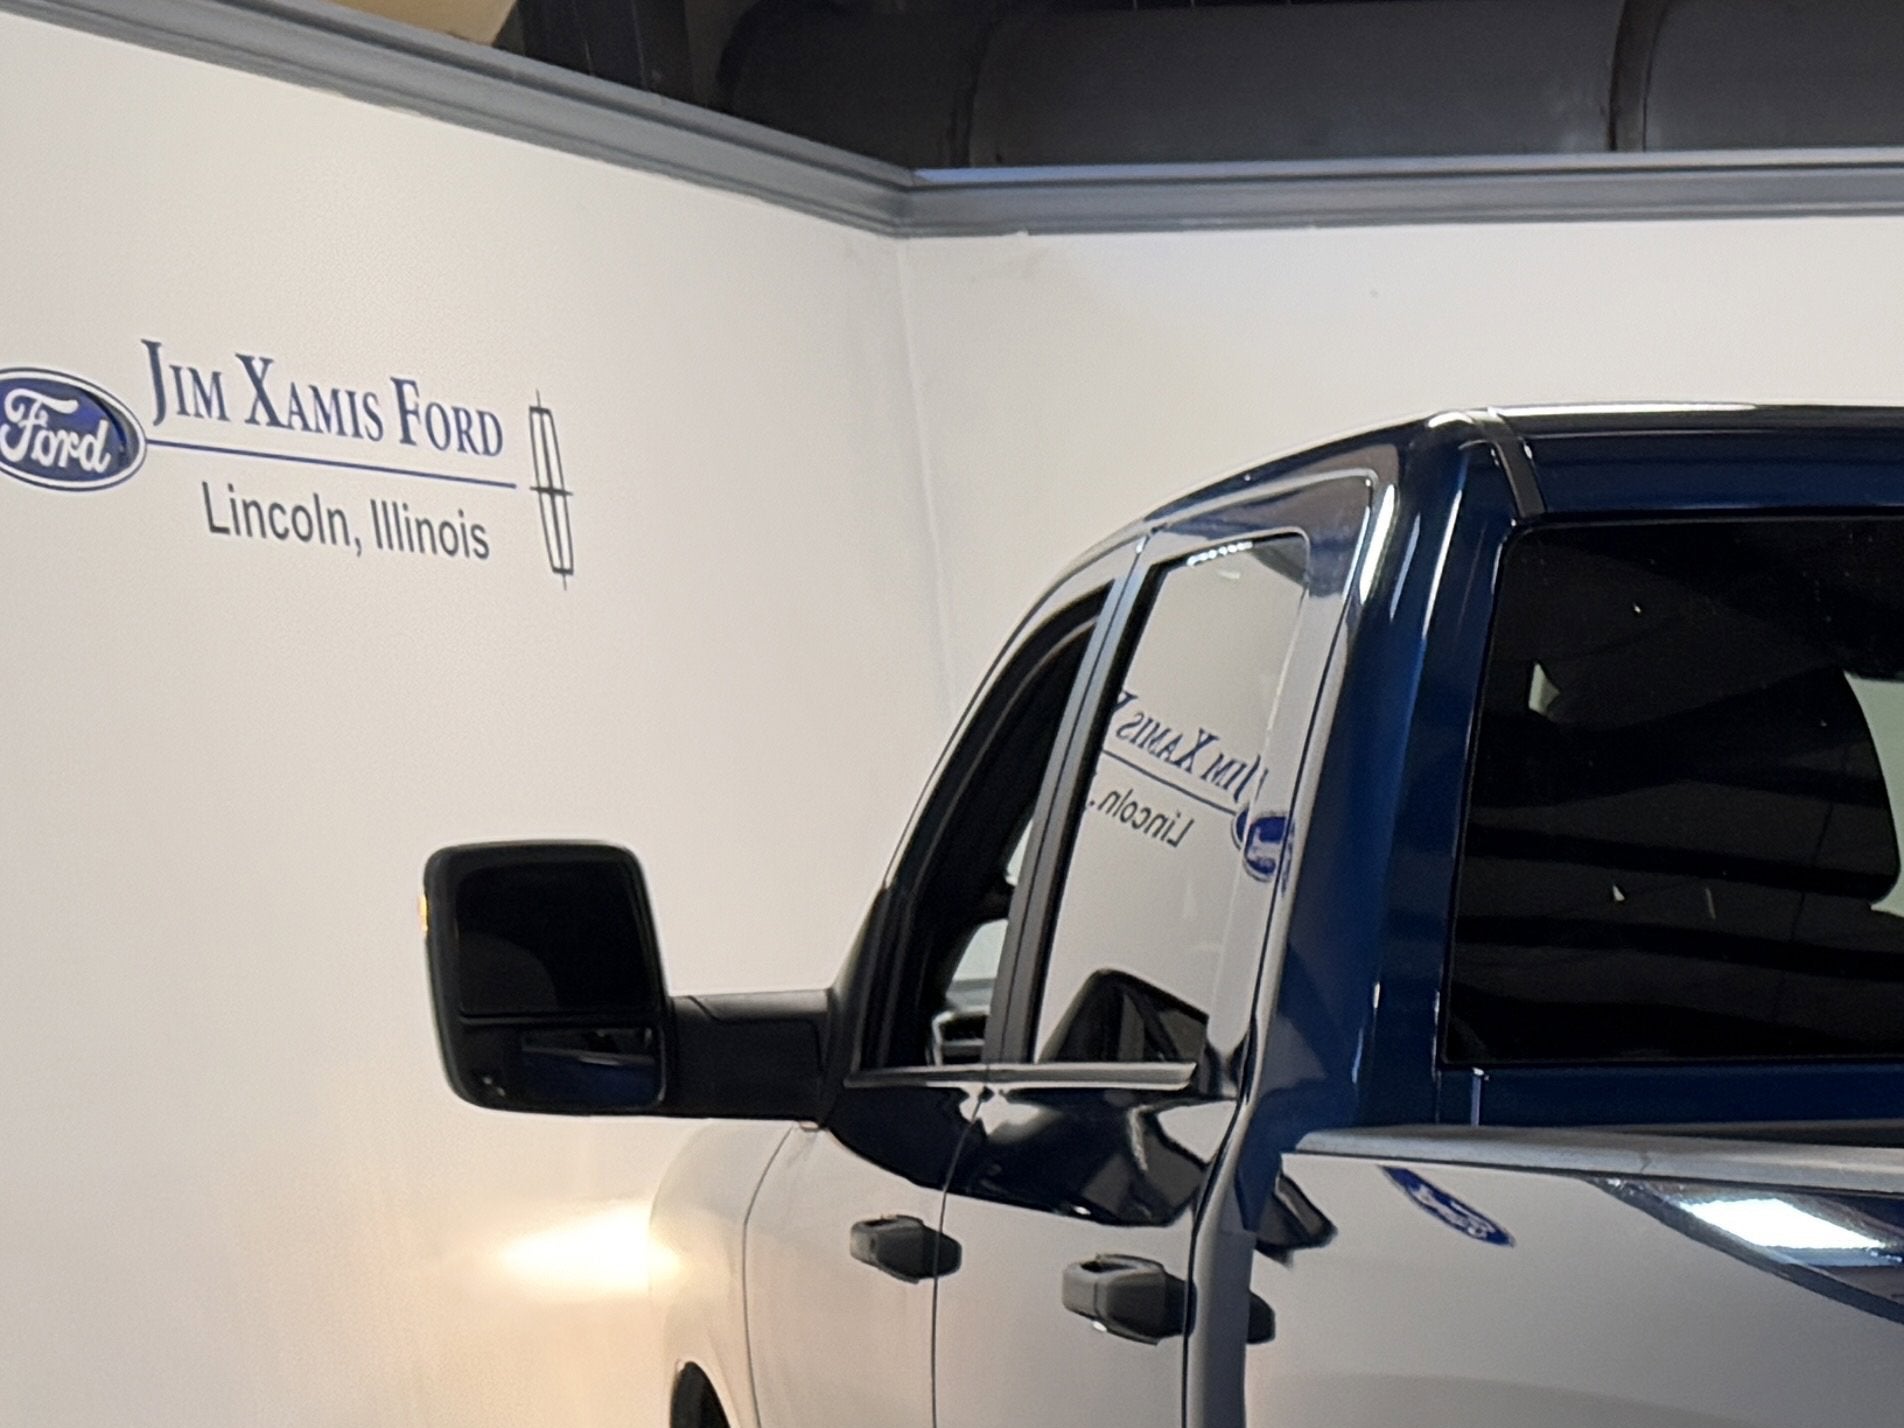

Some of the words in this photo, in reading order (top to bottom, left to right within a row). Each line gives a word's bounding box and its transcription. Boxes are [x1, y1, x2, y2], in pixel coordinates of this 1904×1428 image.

[0, 388, 111, 473] Ford
[141, 338, 230, 426] JIM
[234, 353, 384, 442] XAMIS
[389, 376, 503, 457] FORD
[202, 481, 362, 557] Lincoln,
[370, 499, 490, 559] Illinois
